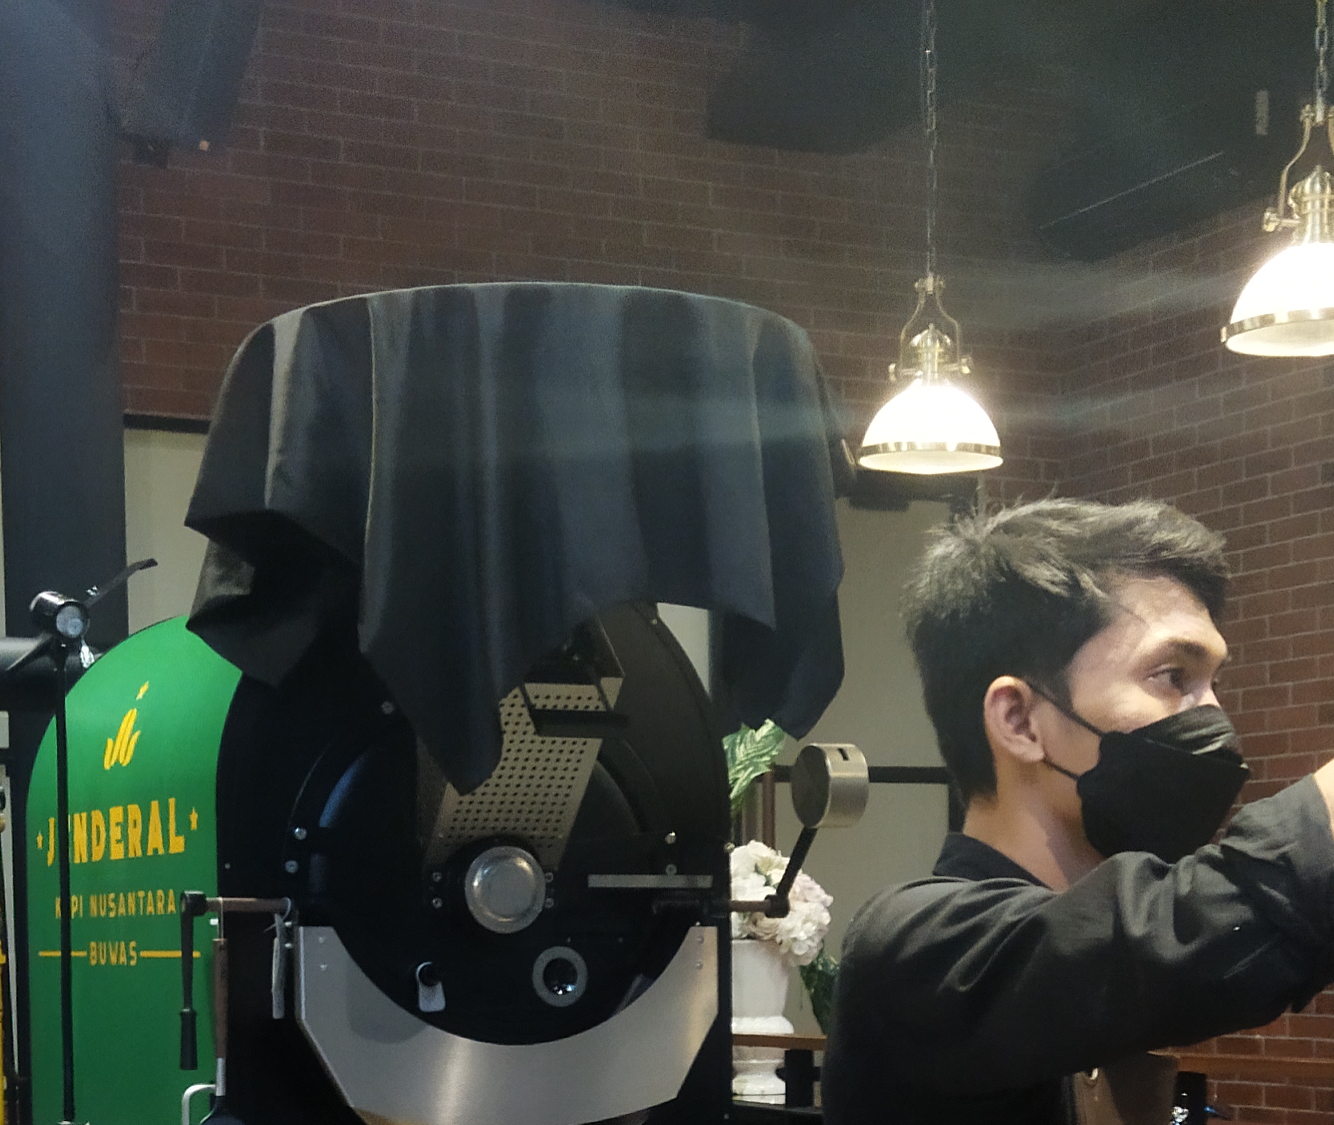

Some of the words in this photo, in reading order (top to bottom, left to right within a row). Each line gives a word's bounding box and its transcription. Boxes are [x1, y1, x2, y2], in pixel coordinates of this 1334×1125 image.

[47, 798, 185, 866] JNDERAL
[55, 895, 83, 919] KPI
[89, 889, 177, 918] NUSANTARA
[89, 940, 138, 966] BUWAS
